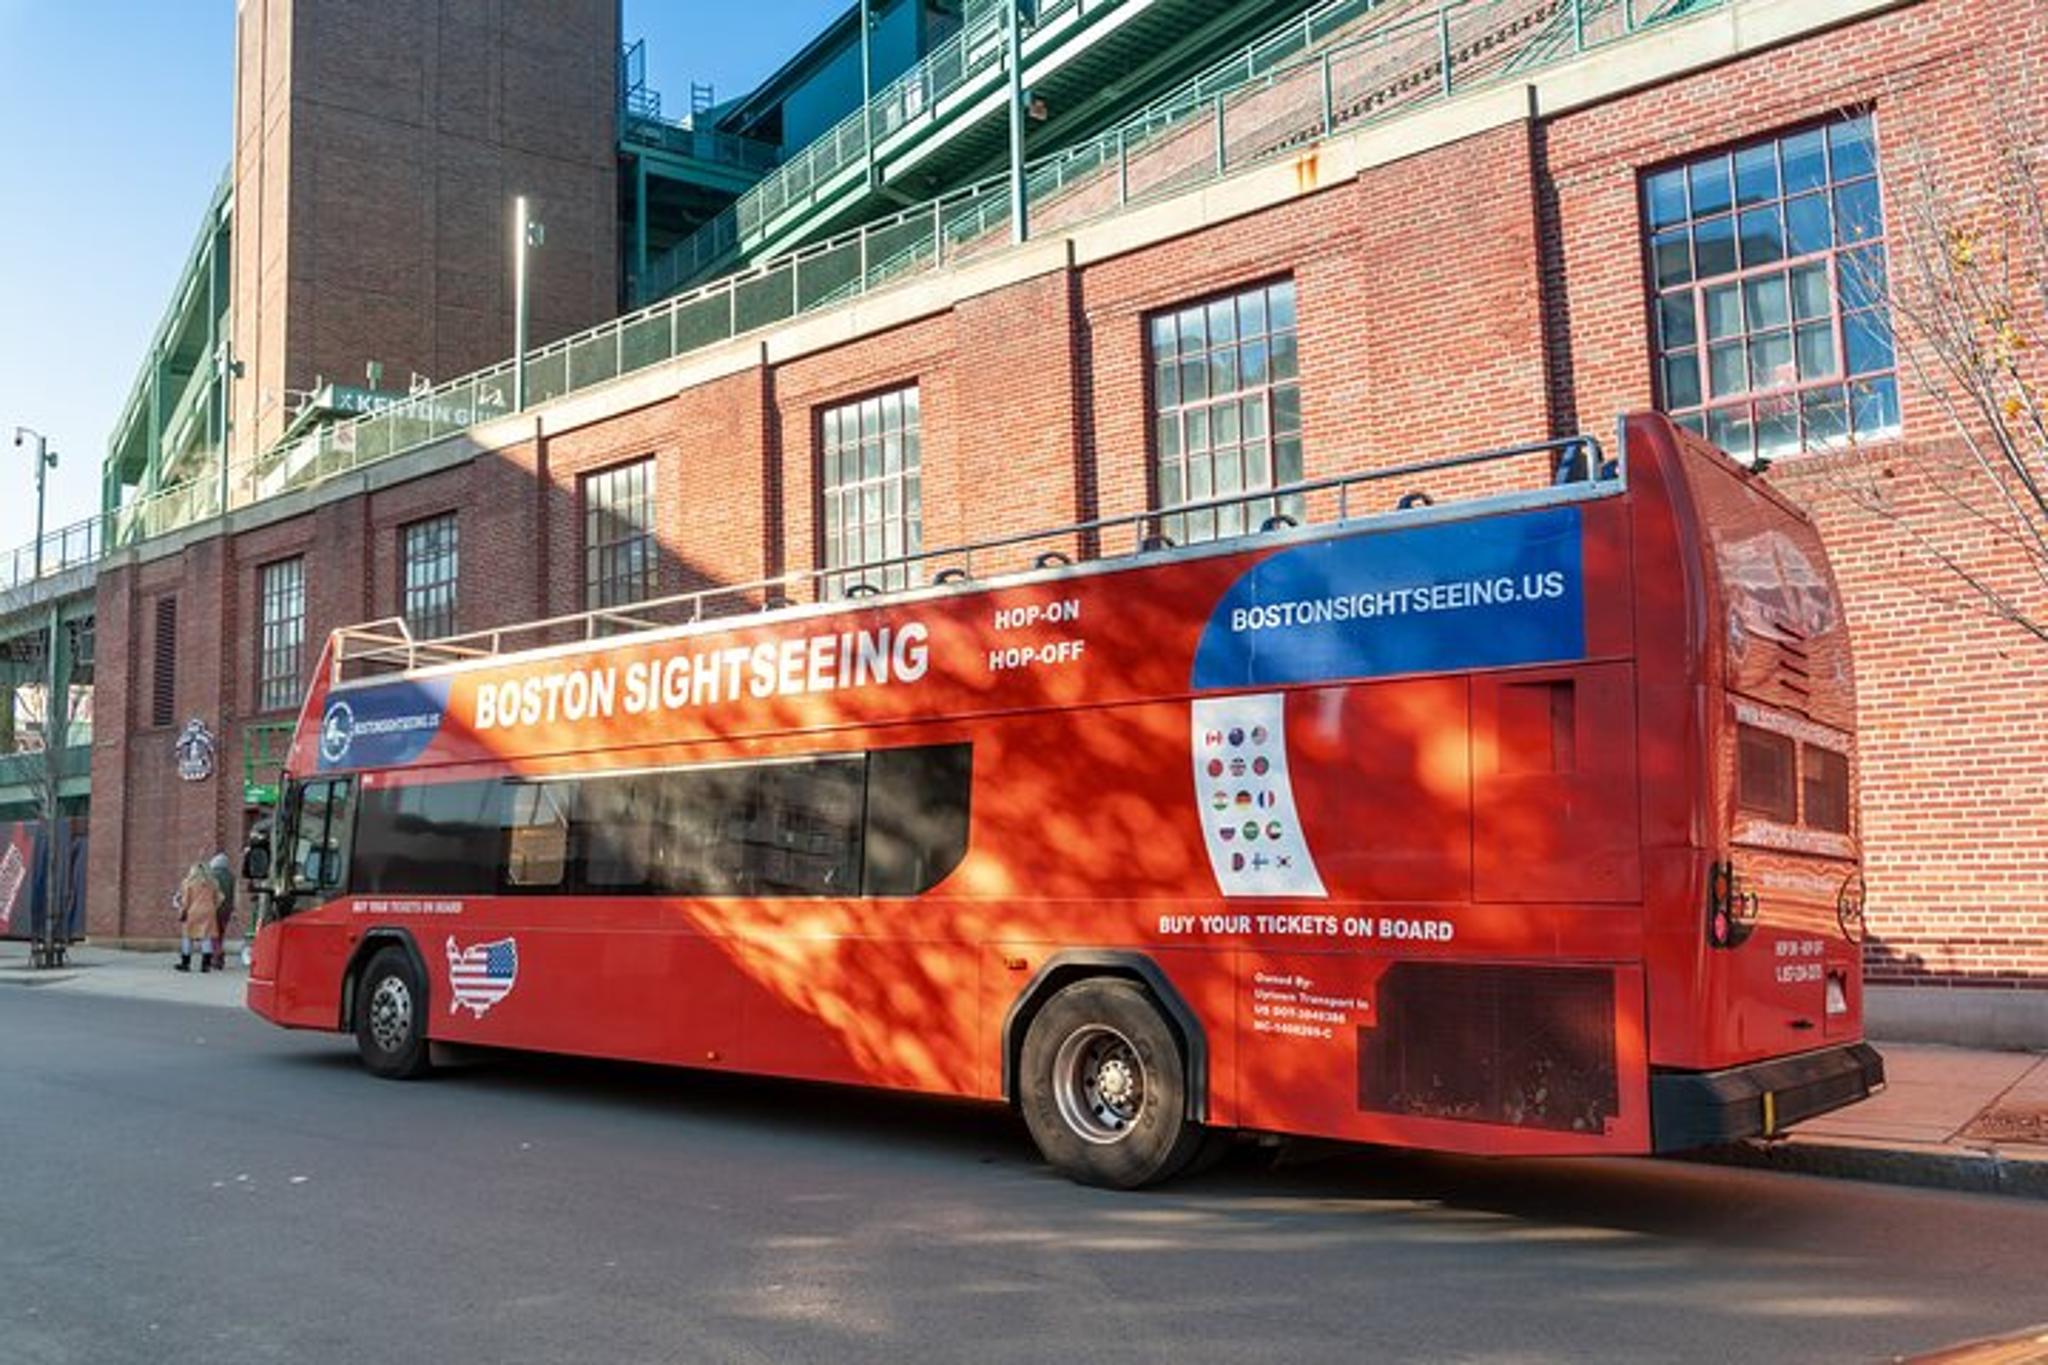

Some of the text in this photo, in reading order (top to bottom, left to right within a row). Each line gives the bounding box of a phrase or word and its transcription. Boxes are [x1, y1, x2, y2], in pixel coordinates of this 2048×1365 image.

[995, 599, 1080, 630] HOP-ON
[1232, 571, 1565, 632] BOSTONSIGHTSEEING.US
[989, 639, 1084, 671] HOP-OFF
[475, 622, 930, 729] BOSTON SIGHTSEEING
[1159, 915, 1454, 940] BUY YOUR TICKETS ON BOARD
[1254, 971, 1292, 985] Owned
[1299, 992, 1354, 1008] Transport
